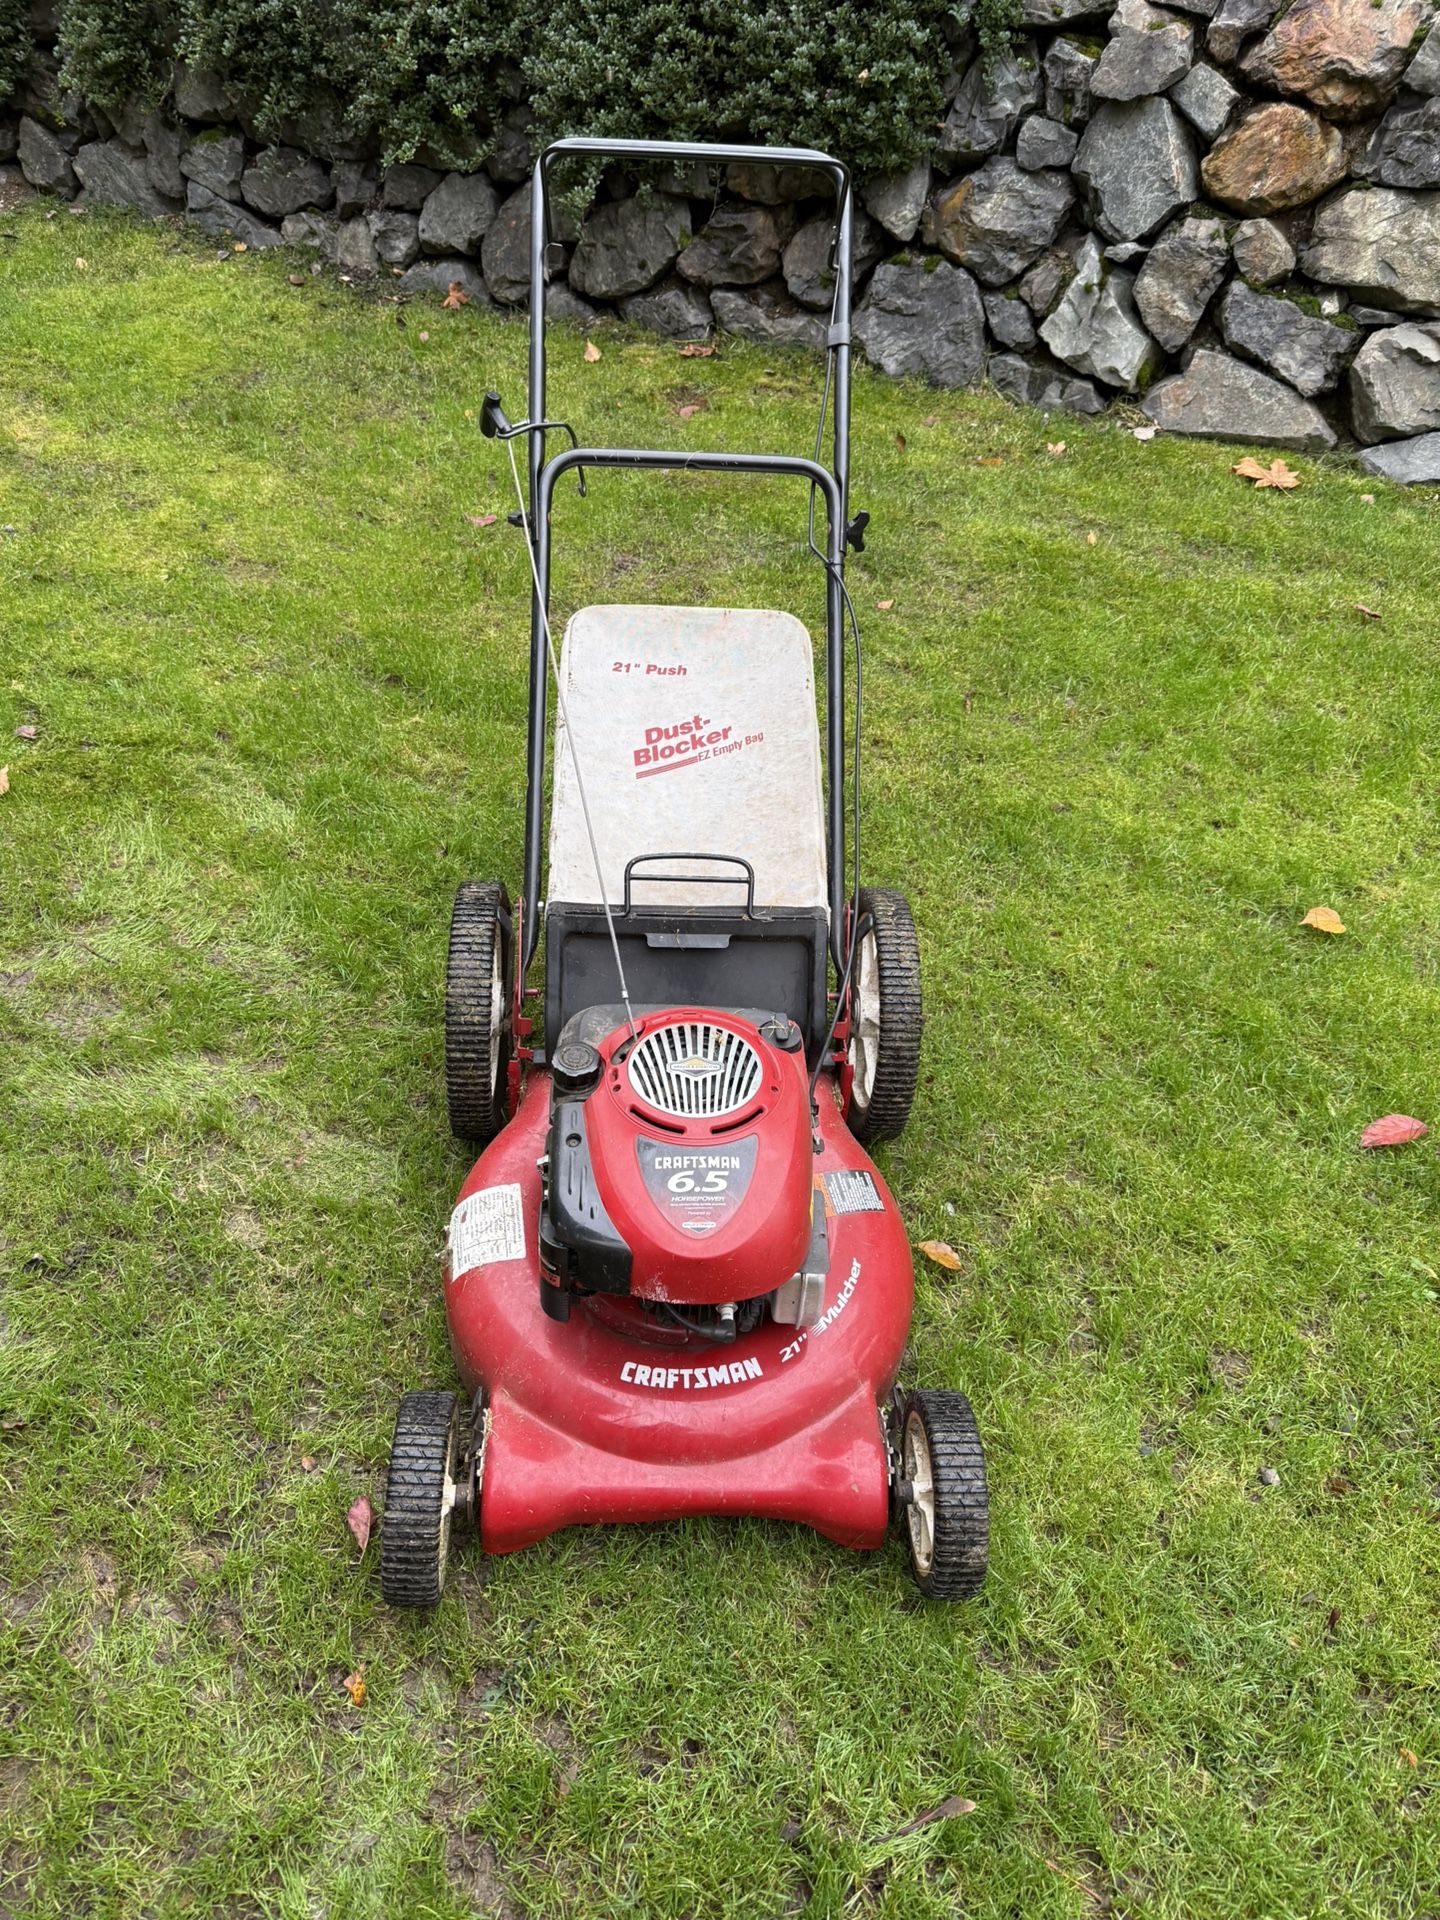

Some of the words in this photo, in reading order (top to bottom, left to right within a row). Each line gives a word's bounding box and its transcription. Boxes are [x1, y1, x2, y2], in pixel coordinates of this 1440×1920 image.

[612, 662, 640, 673] 21"
[645, 664, 688, 676] Push
[645, 714, 711, 746] Dust-
[633, 726, 732, 766] Blocker
[698, 750, 711, 762] EZ
[713, 740, 743, 757] Empty
[745, 732, 764, 746] Bag
[655, 1155, 740, 1169] CRAFTSMAN
[667, 1170, 730, 1193] 6.5
[779, 1332, 808, 1363] 21"
[810, 1257, 861, 1337] Mulcher
[620, 1356, 764, 1389] CRAFTSMAN
